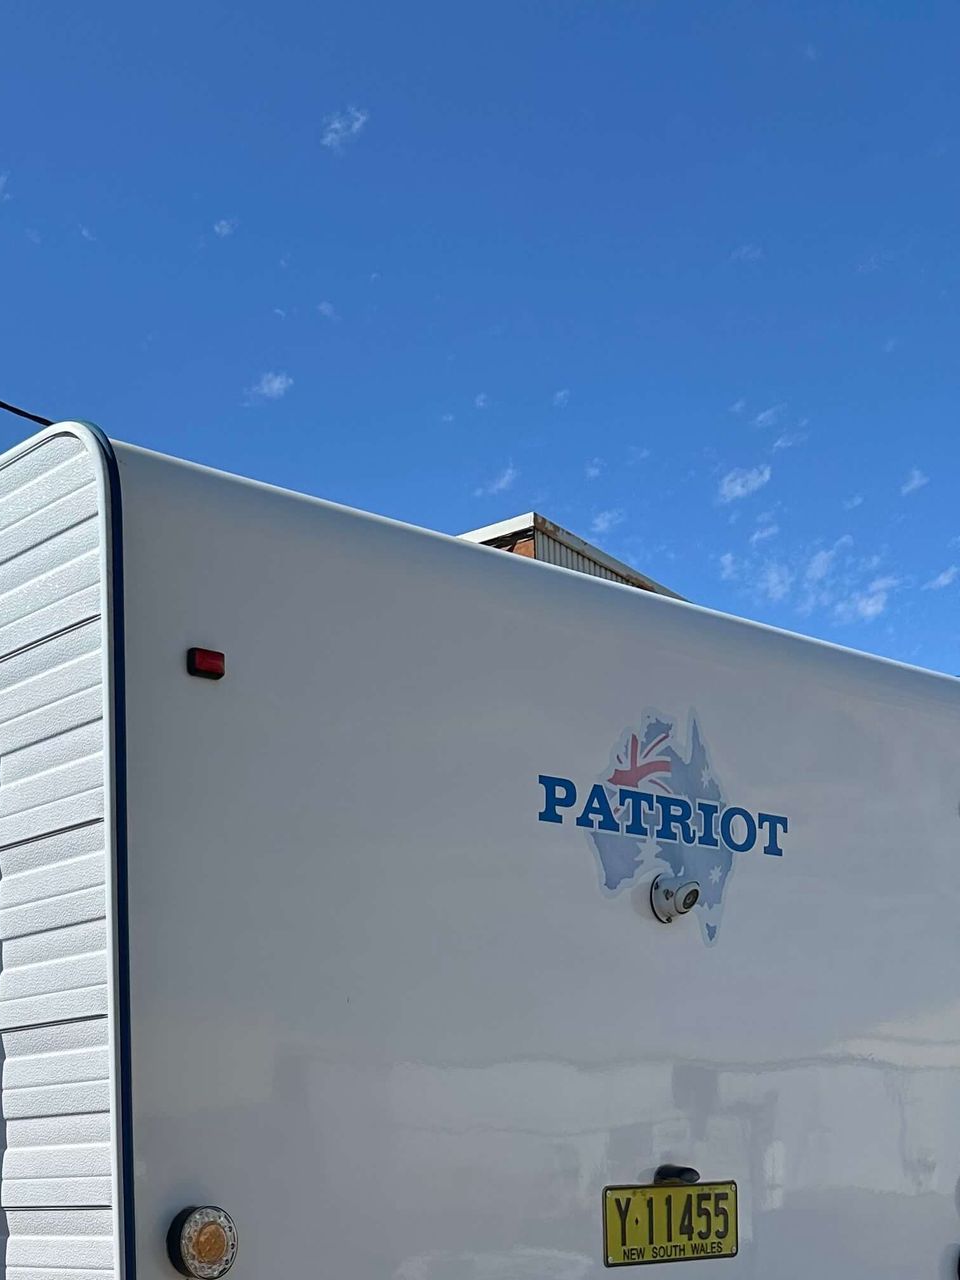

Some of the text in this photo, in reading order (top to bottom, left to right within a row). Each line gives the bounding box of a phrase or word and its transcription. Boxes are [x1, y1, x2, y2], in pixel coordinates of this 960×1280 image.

[538, 774, 789, 857] PATRIOT
[623, 1241, 723, 1262] NEW SOUTH WALES
